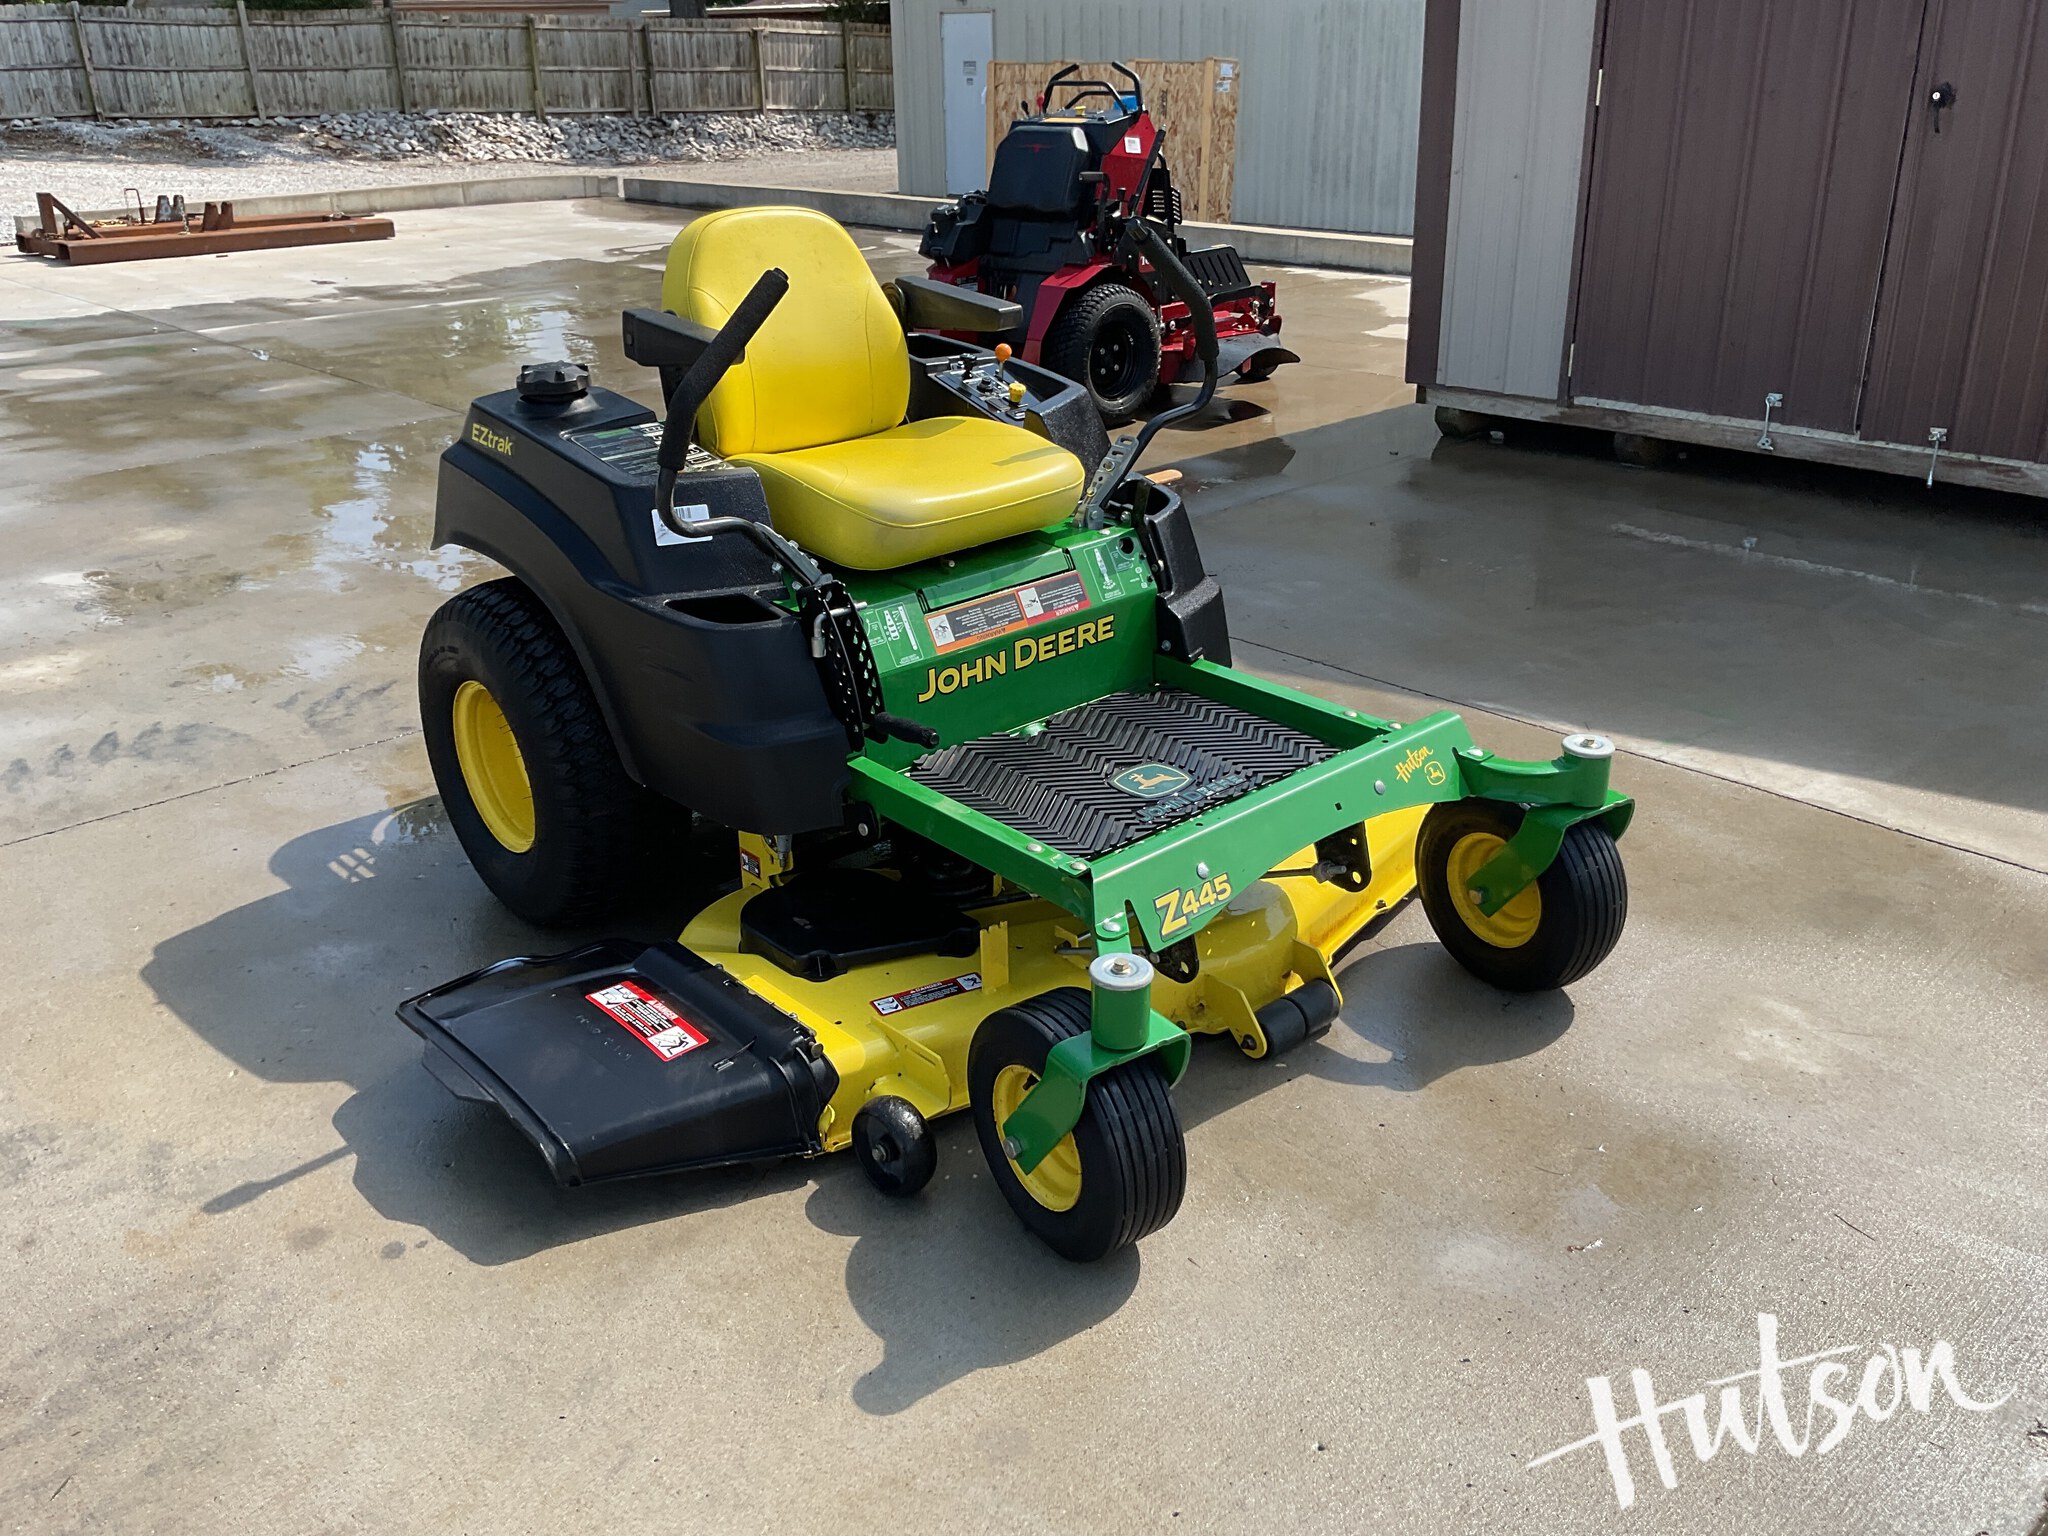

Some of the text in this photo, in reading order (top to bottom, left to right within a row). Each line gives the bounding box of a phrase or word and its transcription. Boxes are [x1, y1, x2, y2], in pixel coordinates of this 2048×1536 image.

[471, 423, 512, 456] EZtrak
[918, 650, 1006, 703] JOHN
[1014, 614, 1115, 670] DEERE
[1395, 745, 1434, 783] Hutson
[1155, 873, 1232, 937] Z445
